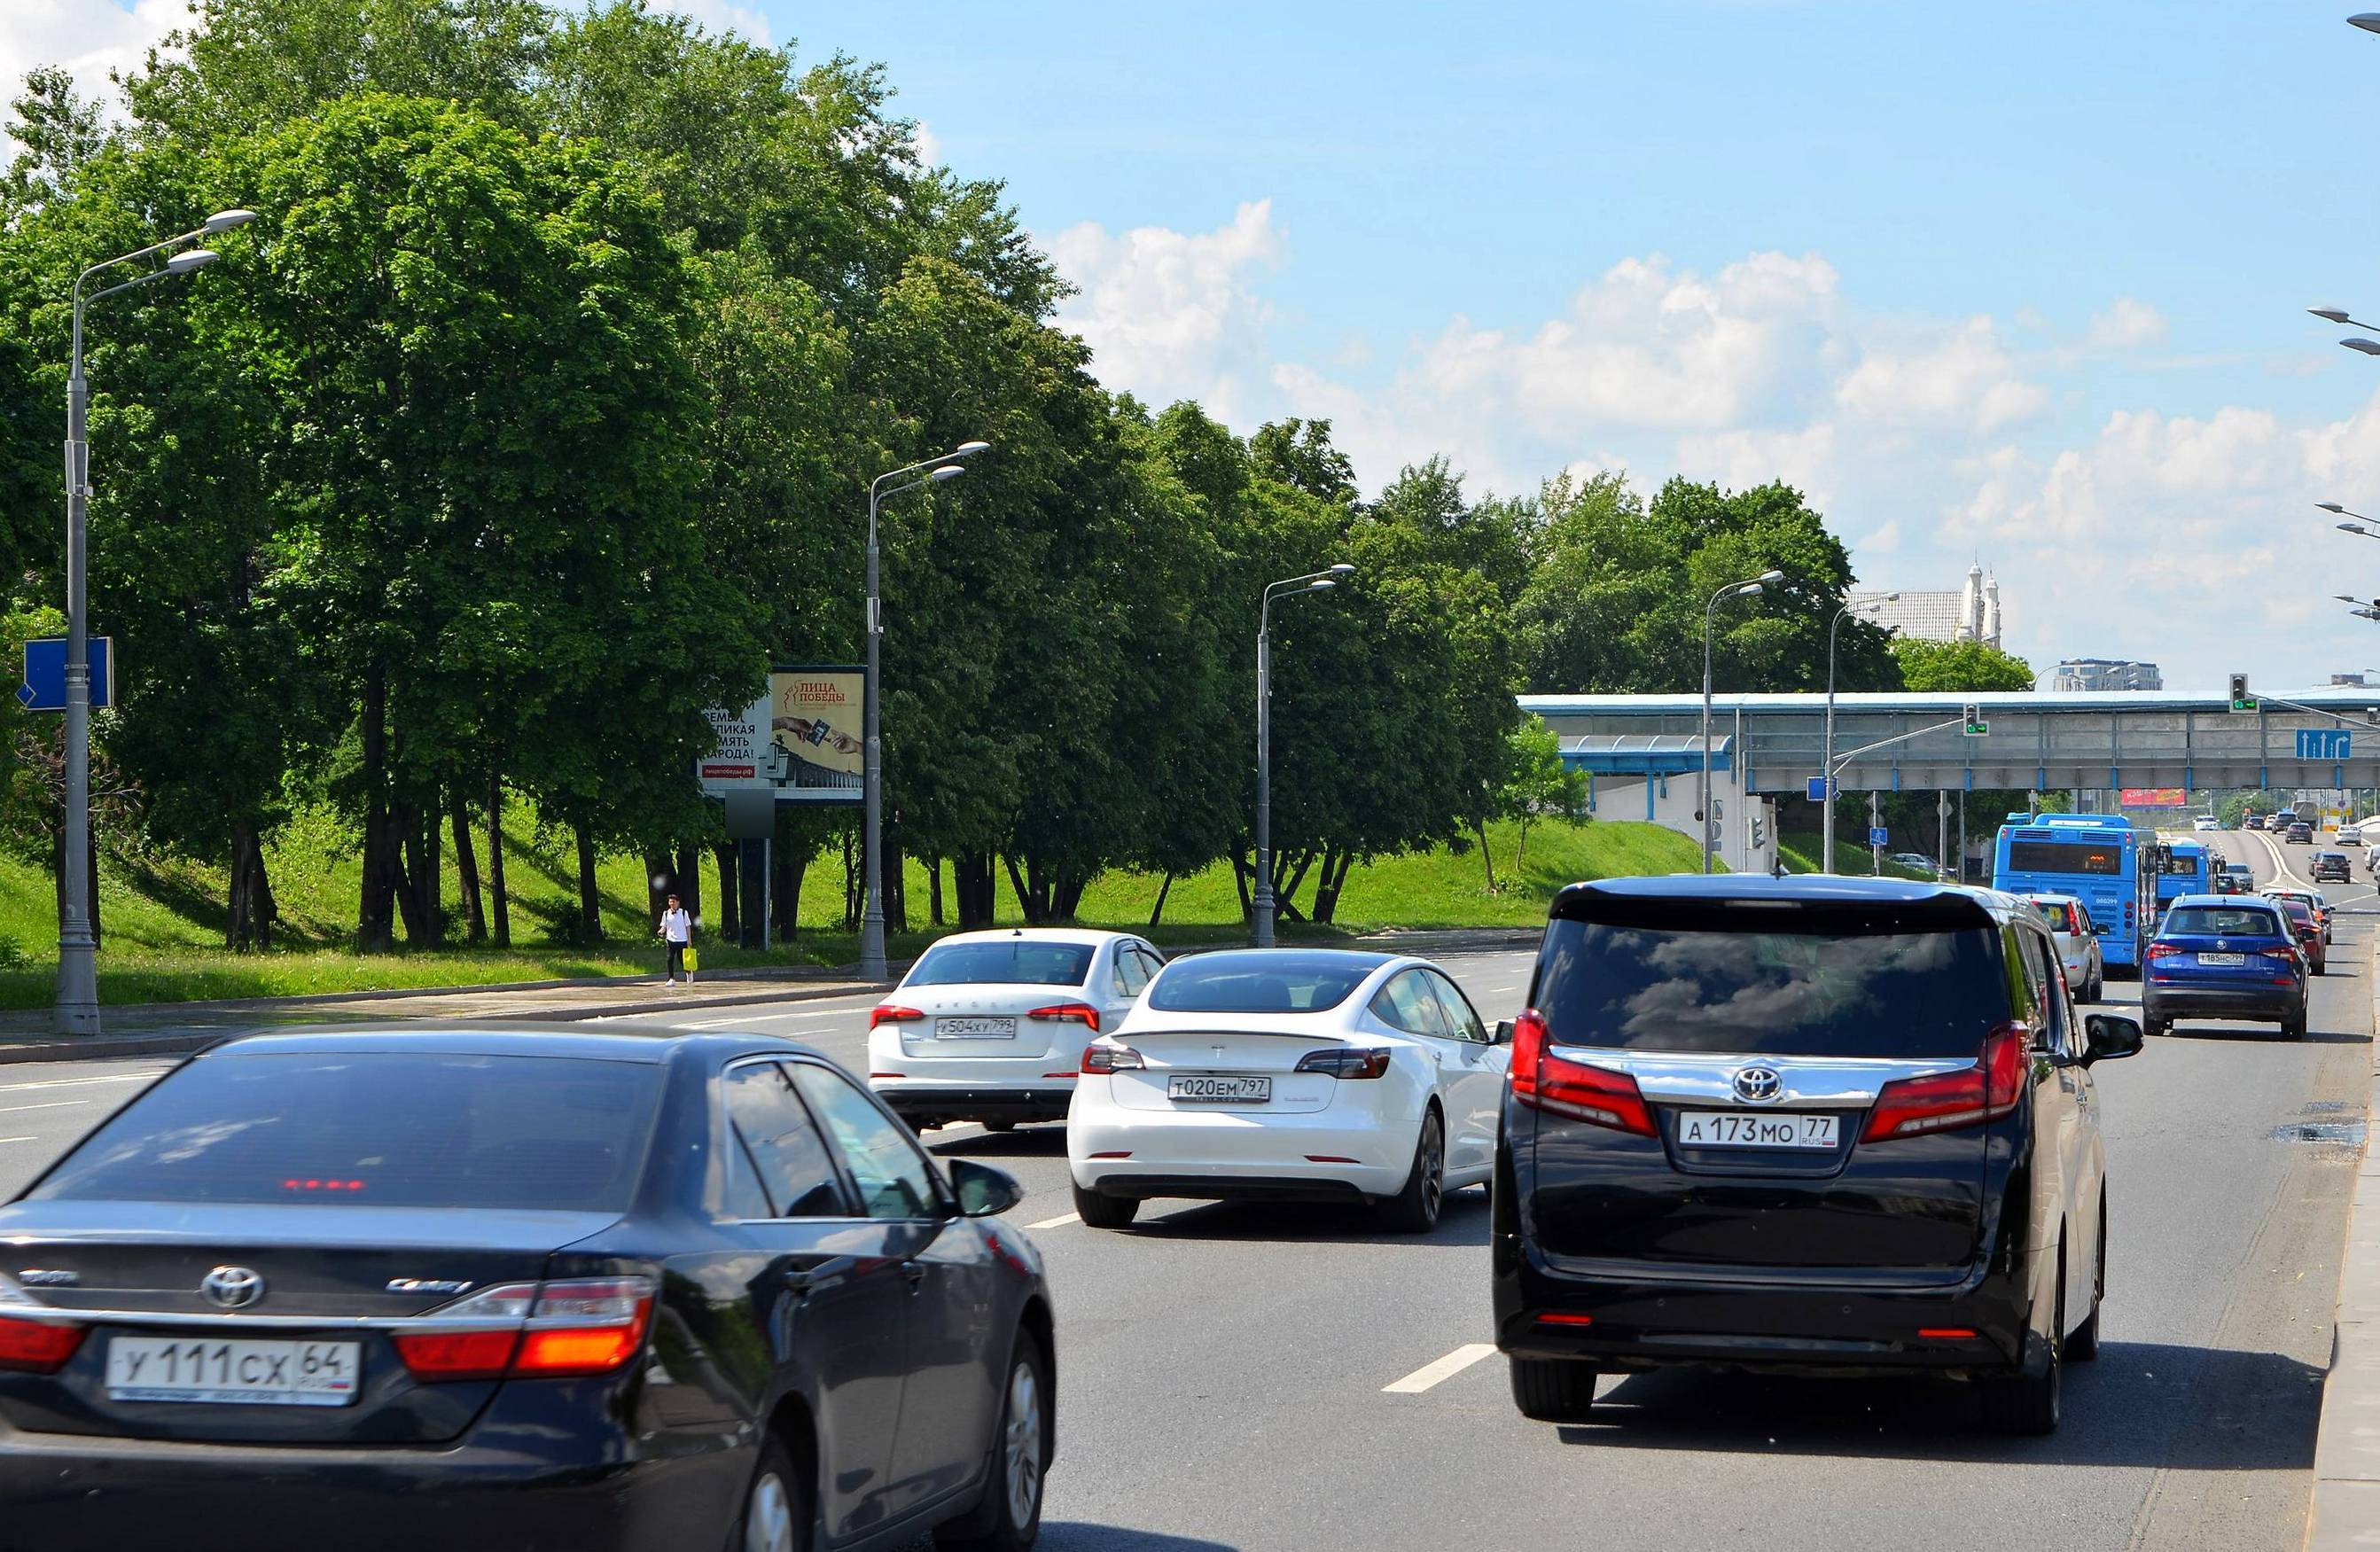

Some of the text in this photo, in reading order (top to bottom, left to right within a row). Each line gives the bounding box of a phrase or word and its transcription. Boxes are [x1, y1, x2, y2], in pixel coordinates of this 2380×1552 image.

[800, 682, 836, 694] ЛИЦА
[800, 693, 845, 702] ПОБЕДЫ
[715, 725, 755, 735] ЛИКАЯ
[718, 737, 749, 746] МЯТЬ
[709, 749, 753, 760] АРОДА!
[1175, 1079, 1237, 1096] Т020ЕМ
[1241, 1079, 1264, 1092] 797
[1688, 1117, 1831, 1143] А173МО 77
[126, 1343, 290, 1385] У111СХ
[300, 1344, 342, 1376] 64
